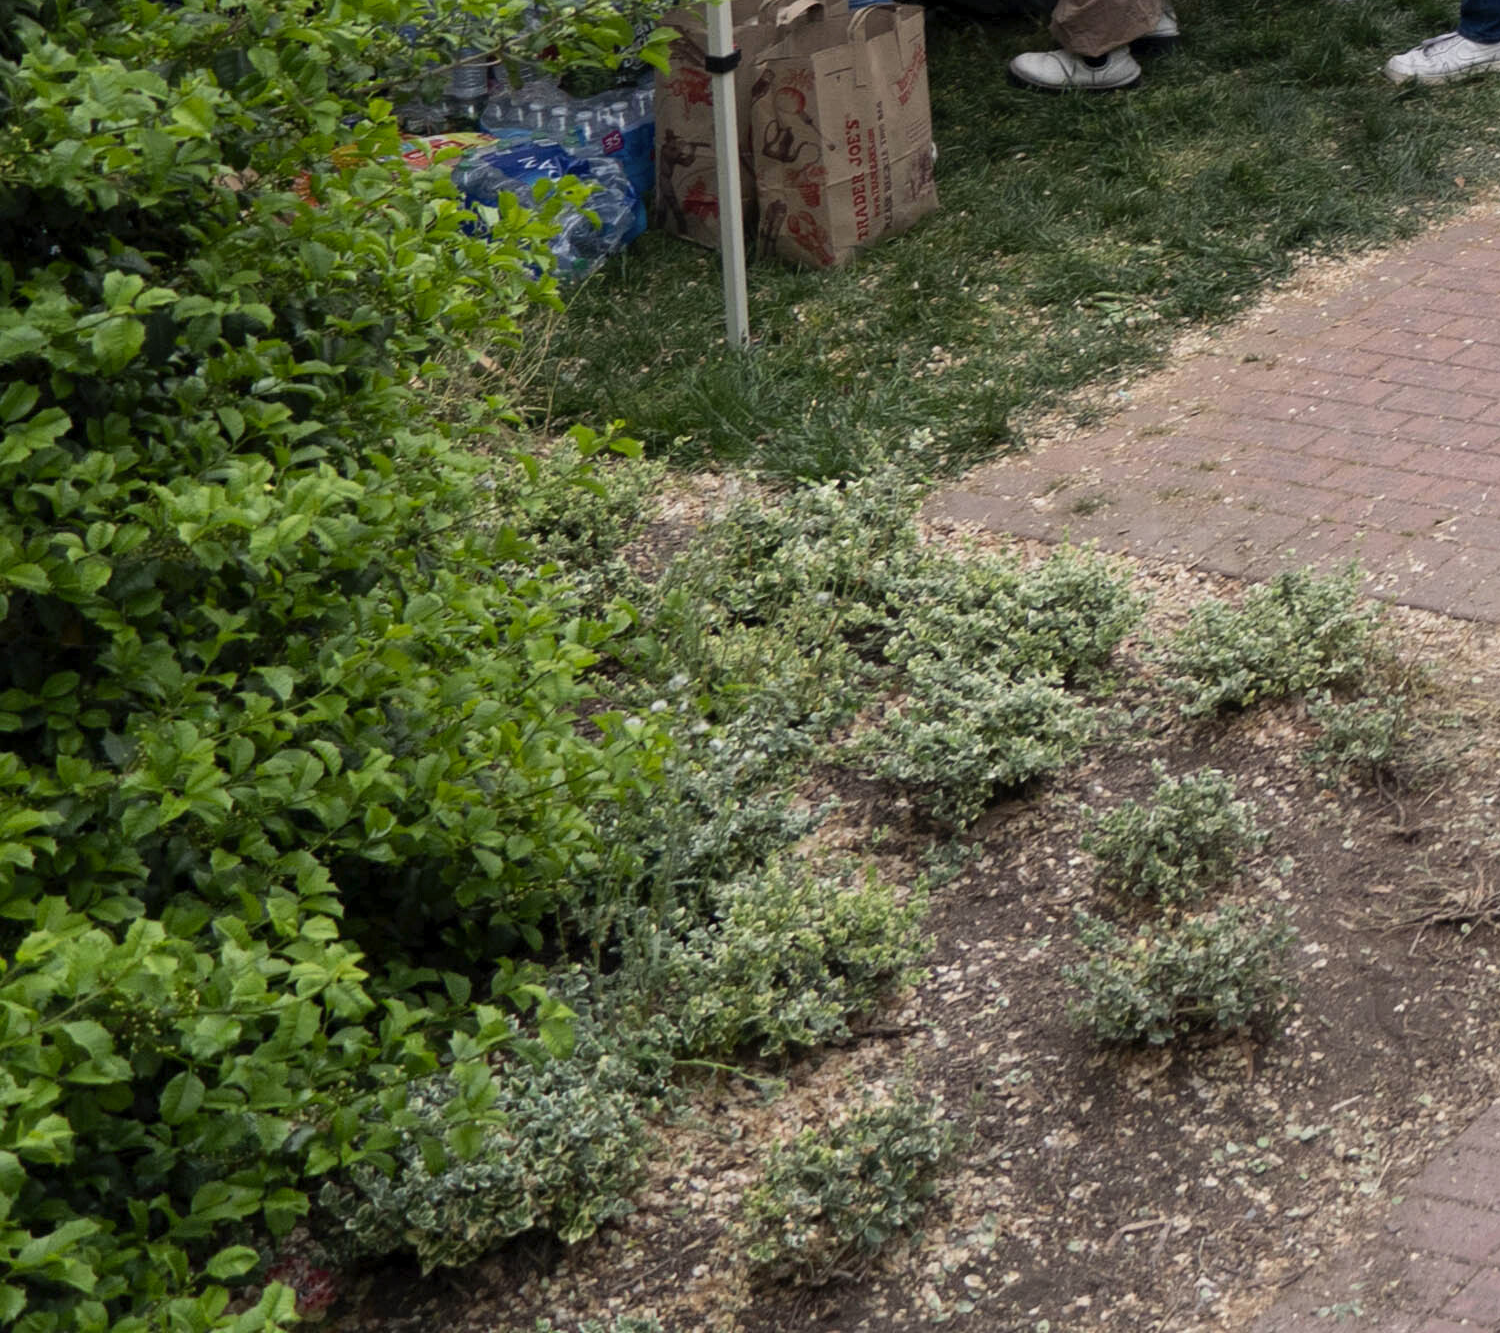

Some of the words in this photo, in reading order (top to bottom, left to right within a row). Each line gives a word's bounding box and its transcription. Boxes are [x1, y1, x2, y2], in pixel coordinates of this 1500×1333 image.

[602, 134, 622, 152] 35
[845, 119, 863, 167] JOE'S
[851, 171, 870, 241] TRADER
